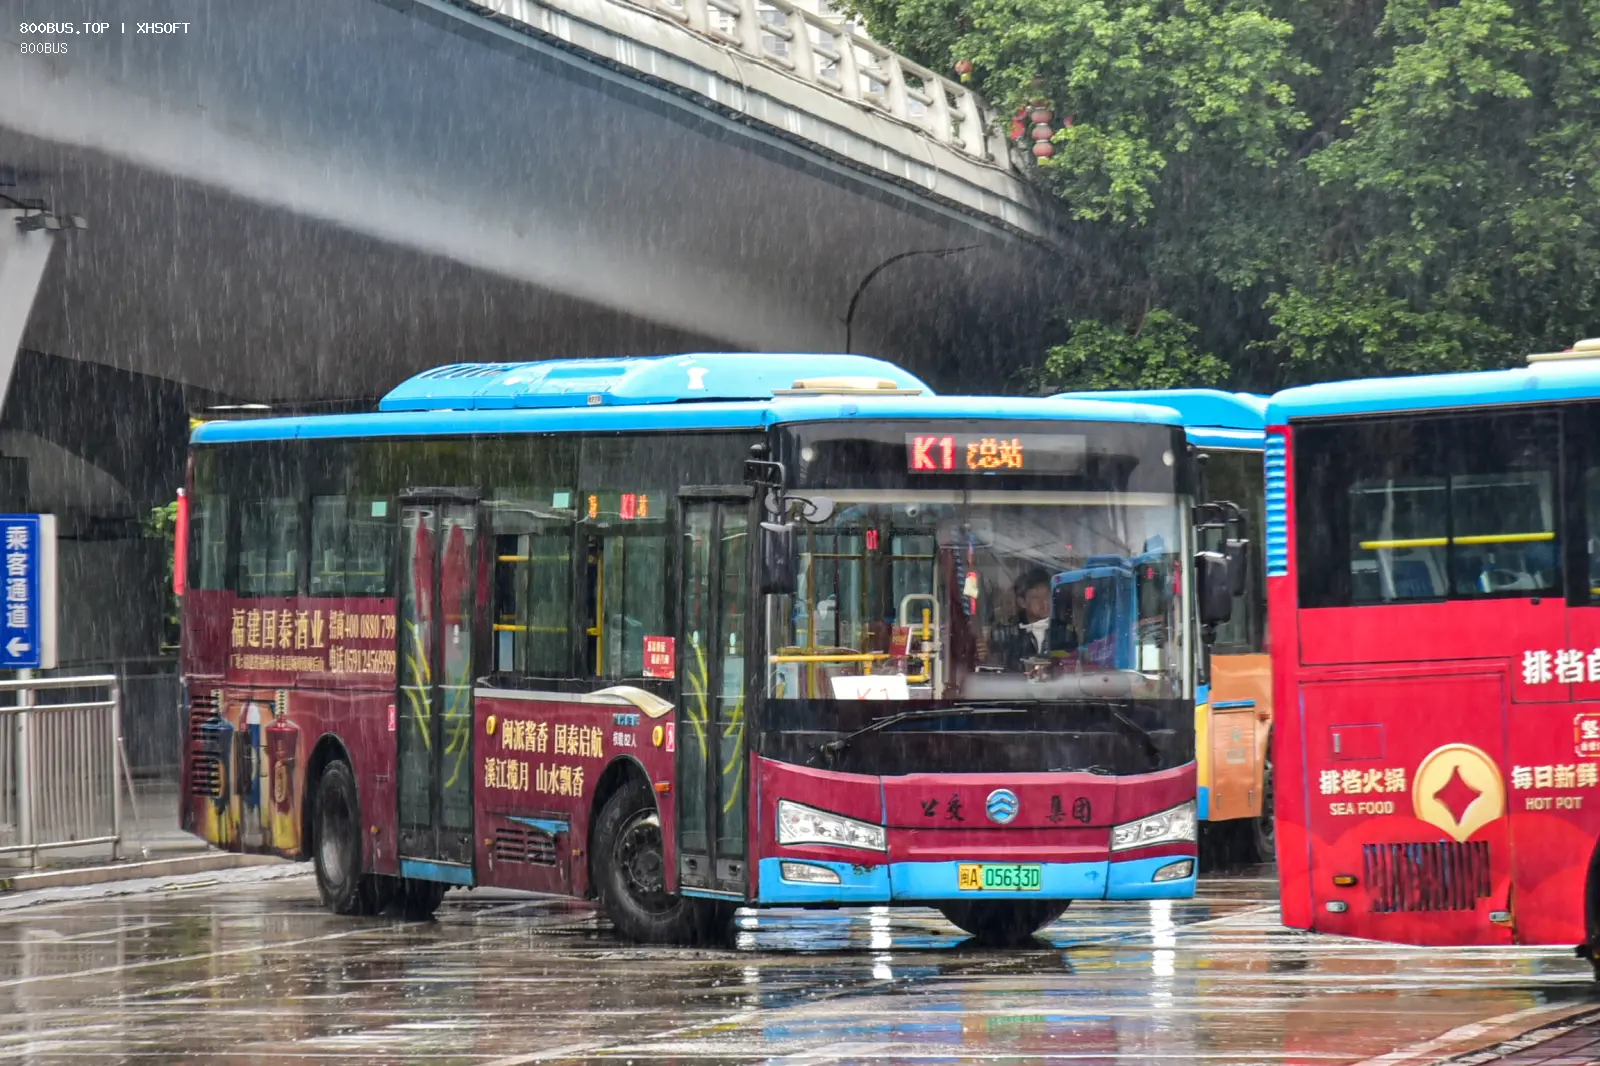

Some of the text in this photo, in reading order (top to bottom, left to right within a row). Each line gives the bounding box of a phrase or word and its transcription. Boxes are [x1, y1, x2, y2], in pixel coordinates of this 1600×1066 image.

[913, 435, 956, 470] K1
[5, 525, 29, 629] 乘客通道
[231, 608, 324, 649] 福建国泰酒业
[501, 717, 604, 758] 闽派酱香 国泰启航
[535, 763, 585, 798] 山水飘香
[1319, 768, 1407, 794] 排档火锅
[1511, 762, 1598, 789] 每日新鲜
[1330, 801, 1394, 815] SEA FOOD
[1525, 796, 1583, 810] HOT POT
